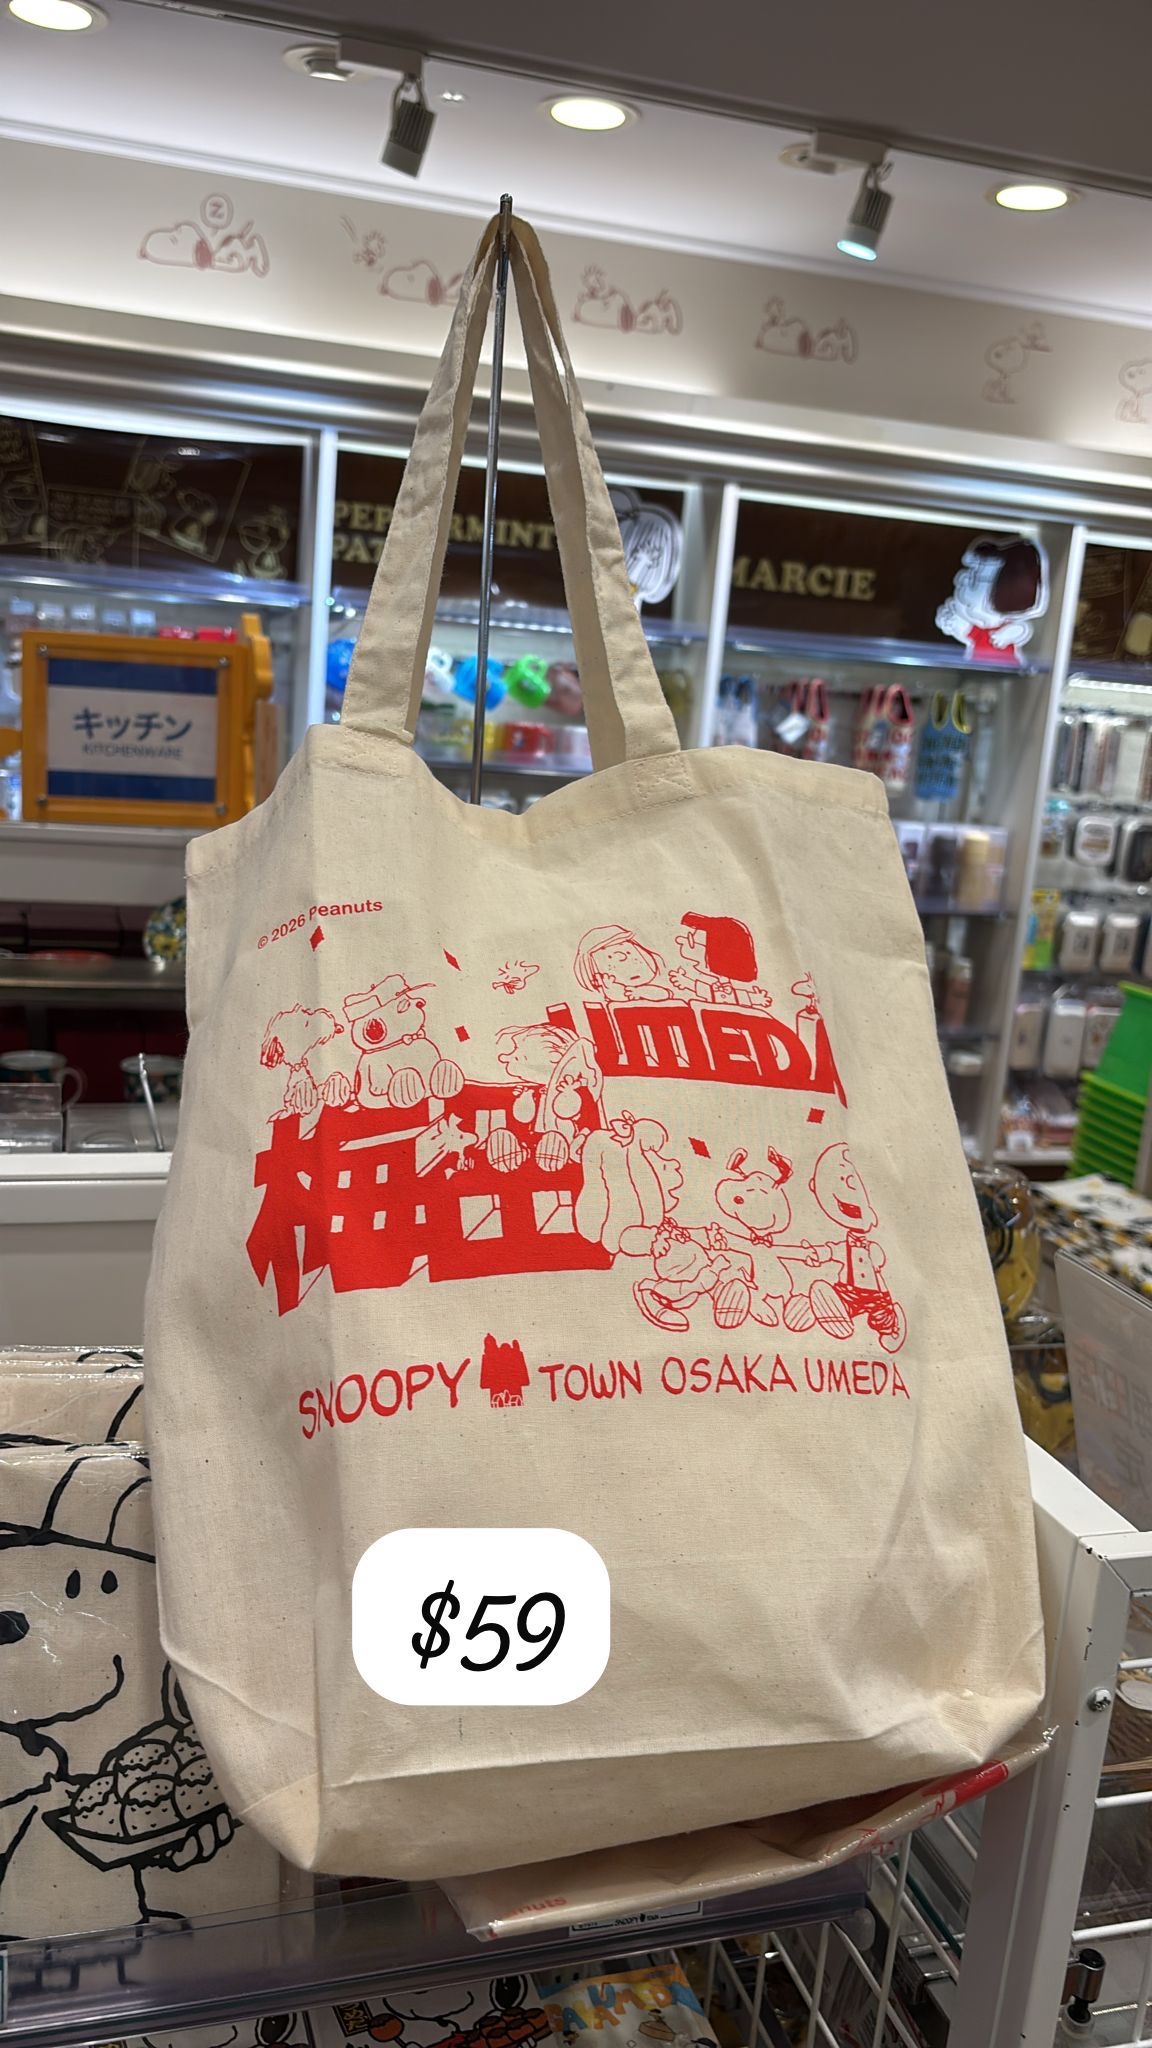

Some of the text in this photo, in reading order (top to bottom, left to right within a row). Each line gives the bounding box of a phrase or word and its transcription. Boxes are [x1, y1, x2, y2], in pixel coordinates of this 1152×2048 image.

[74, 706, 193, 741] キッチン
[271, 914, 306, 942] 2026
[309, 900, 383, 920] Peanuts
[299, 1353, 910, 1439] SNOOPY TOWN OSAKA UMEDA
